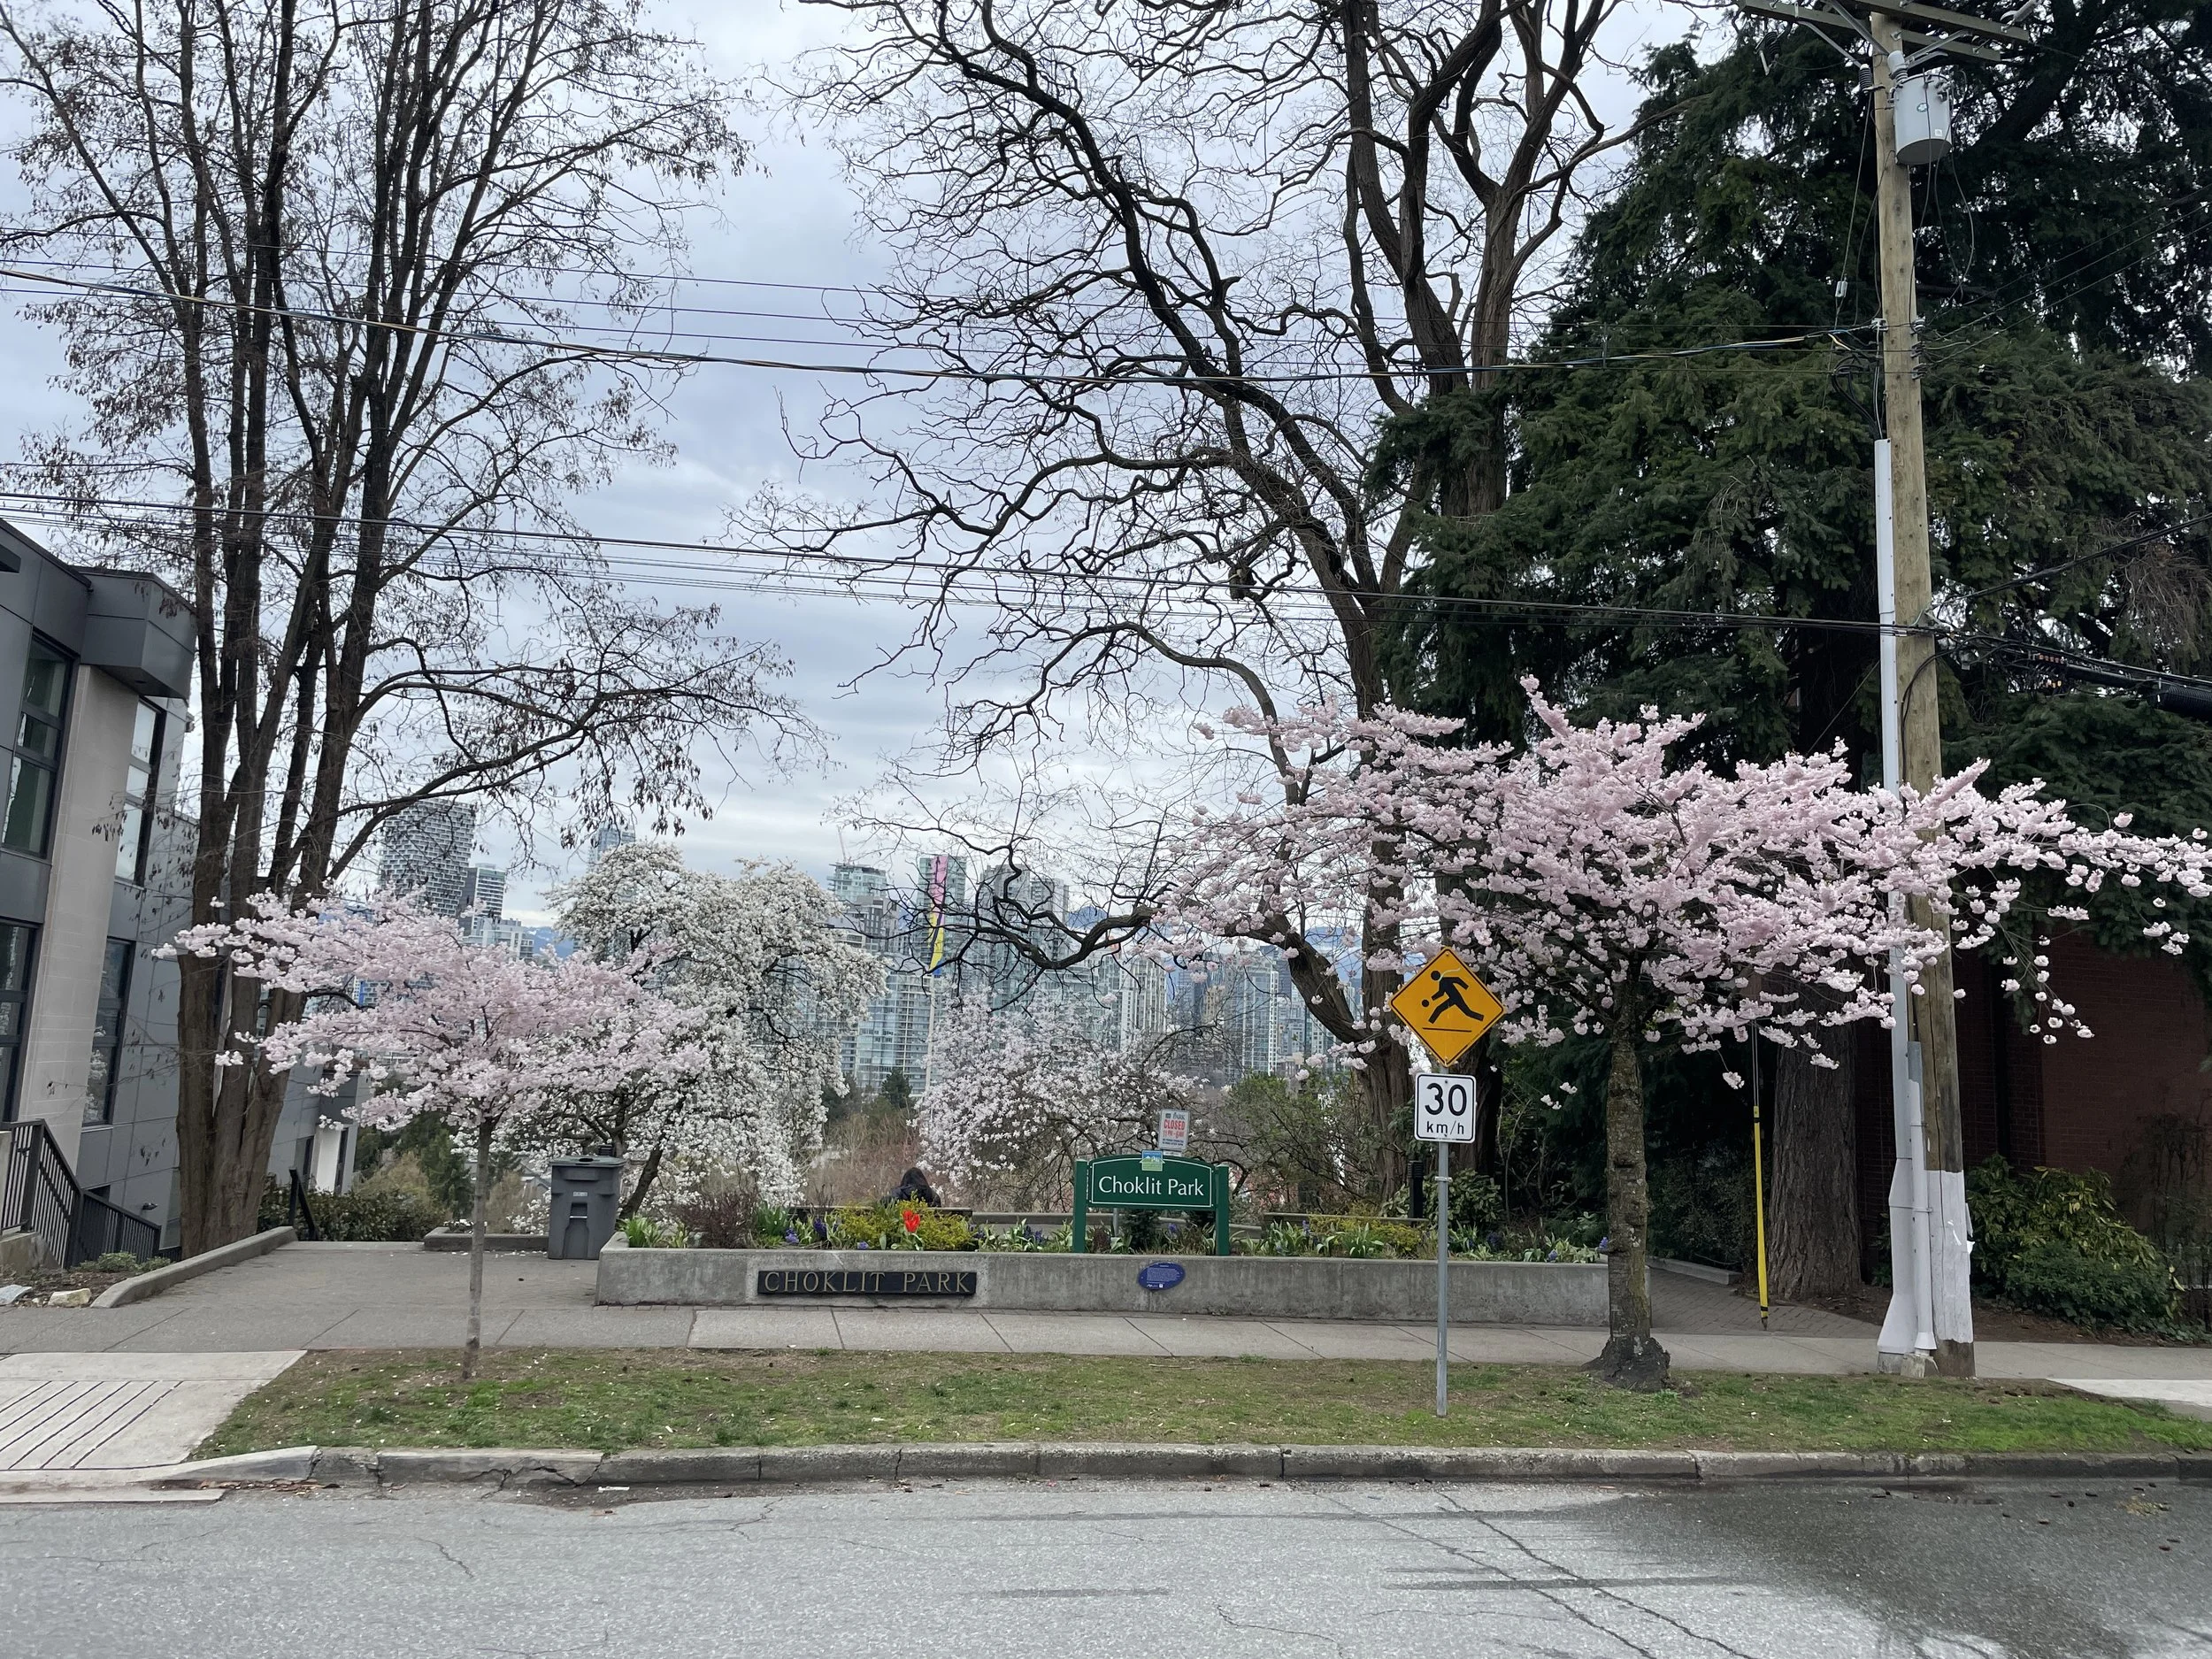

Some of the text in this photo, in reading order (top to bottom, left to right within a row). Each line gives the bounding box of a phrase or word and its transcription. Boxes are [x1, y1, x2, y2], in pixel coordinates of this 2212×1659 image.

[1425, 1082, 1467, 1117] 30
[1164, 1119, 1186, 1130] CLOSED
[1426, 1120, 1464, 1135] km/h
[1098, 1175, 1162, 1194] Choklit
[1168, 1178, 1204, 1196] Park
[764, 1271, 971, 1293] CHOKLIT PARK
